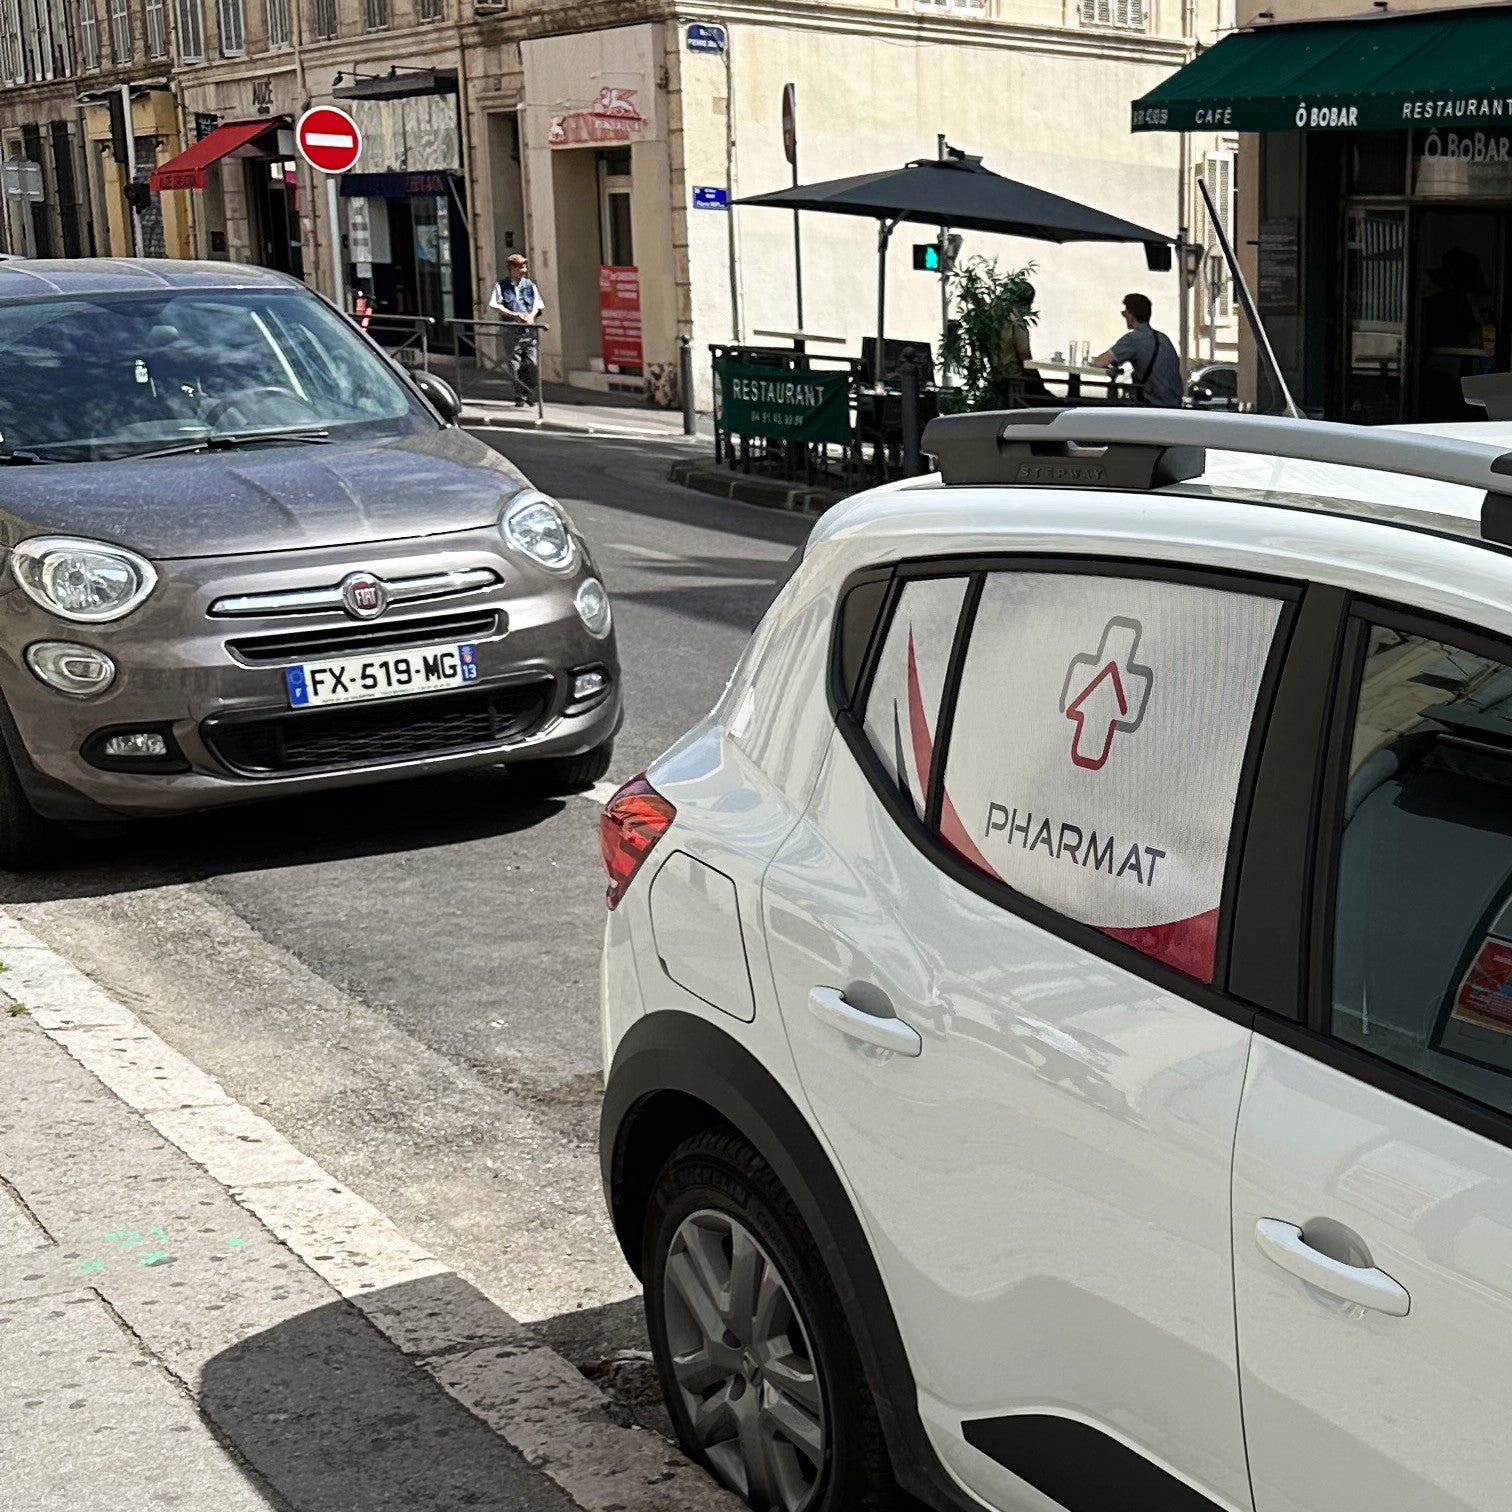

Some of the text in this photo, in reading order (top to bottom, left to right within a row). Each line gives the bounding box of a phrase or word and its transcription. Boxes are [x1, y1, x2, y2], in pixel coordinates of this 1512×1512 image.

[1195, 106, 1233, 125] CAFÉ
[1295, 102, 1307, 127] Ô
[1310, 107, 1358, 127] BOBAR
[732, 378, 824, 407] RESTAURANT
[1020, 466, 1103, 481] STEPWAY
[354, 587, 376, 606] FIAT
[310, 652, 459, 697] FX-519-MG
[462, 664, 477, 679] 13
[295, 687, 302, 698] F
[984, 802, 1166, 887] PHARMAT
